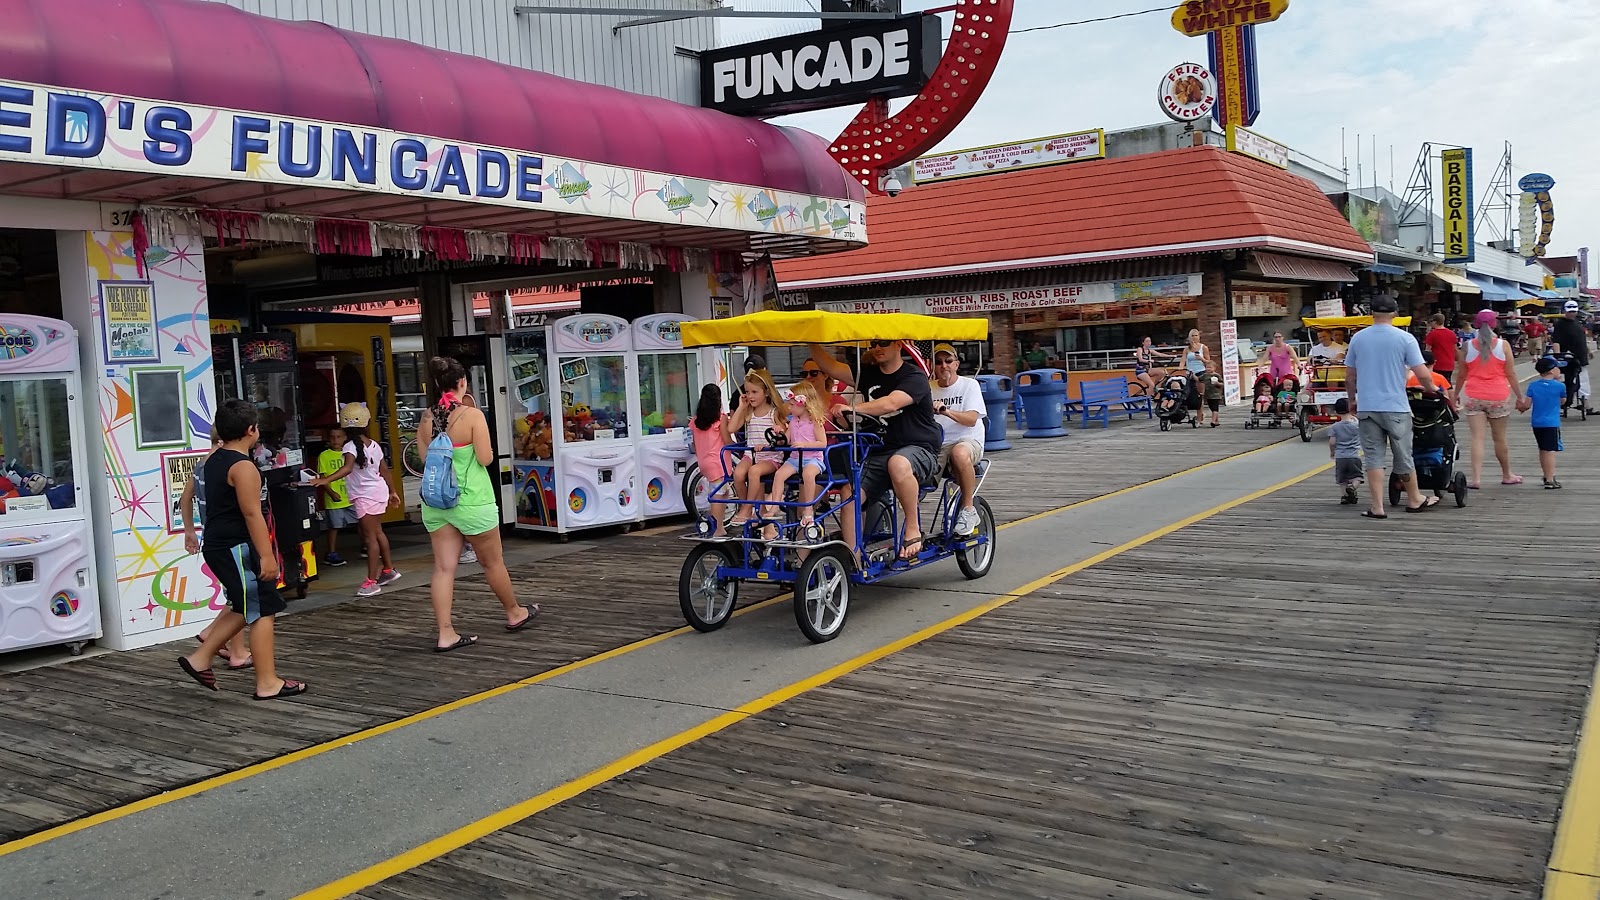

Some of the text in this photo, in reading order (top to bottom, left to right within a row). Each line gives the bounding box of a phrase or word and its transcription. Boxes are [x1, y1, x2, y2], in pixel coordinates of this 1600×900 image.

[1186, 0, 1262, 16] SNO
[1182, 2, 1271, 33] WHITE
[713, 29, 910, 102] FUNCADE
[1168, 65, 1208, 82] FRIED
[1164, 95, 1214, 117] CHICKEN
[231, 115, 544, 203] FUNCADE
[1447, 162, 1463, 256] BARGAINS
[111, 210, 133, 226] 37
[108, 288, 148, 303] WE HAVE IT
[926, 287, 1083, 306] CHICKEN, RIBS, ROAST BEEF
[111, 302, 147, 313] REAL SKEEBALL
[854, 301, 885, 310] BUY 1
[932, 305, 964, 313] DINNERS
[983, 302, 1009, 310] French
[1039, 298, 1056, 306] Cole
[1057, 297, 1077, 305] Slaw
[112, 327, 149, 341] Moolah
[169, 458, 199, 474] WE HAV
[173, 473, 184, 483] REAL
